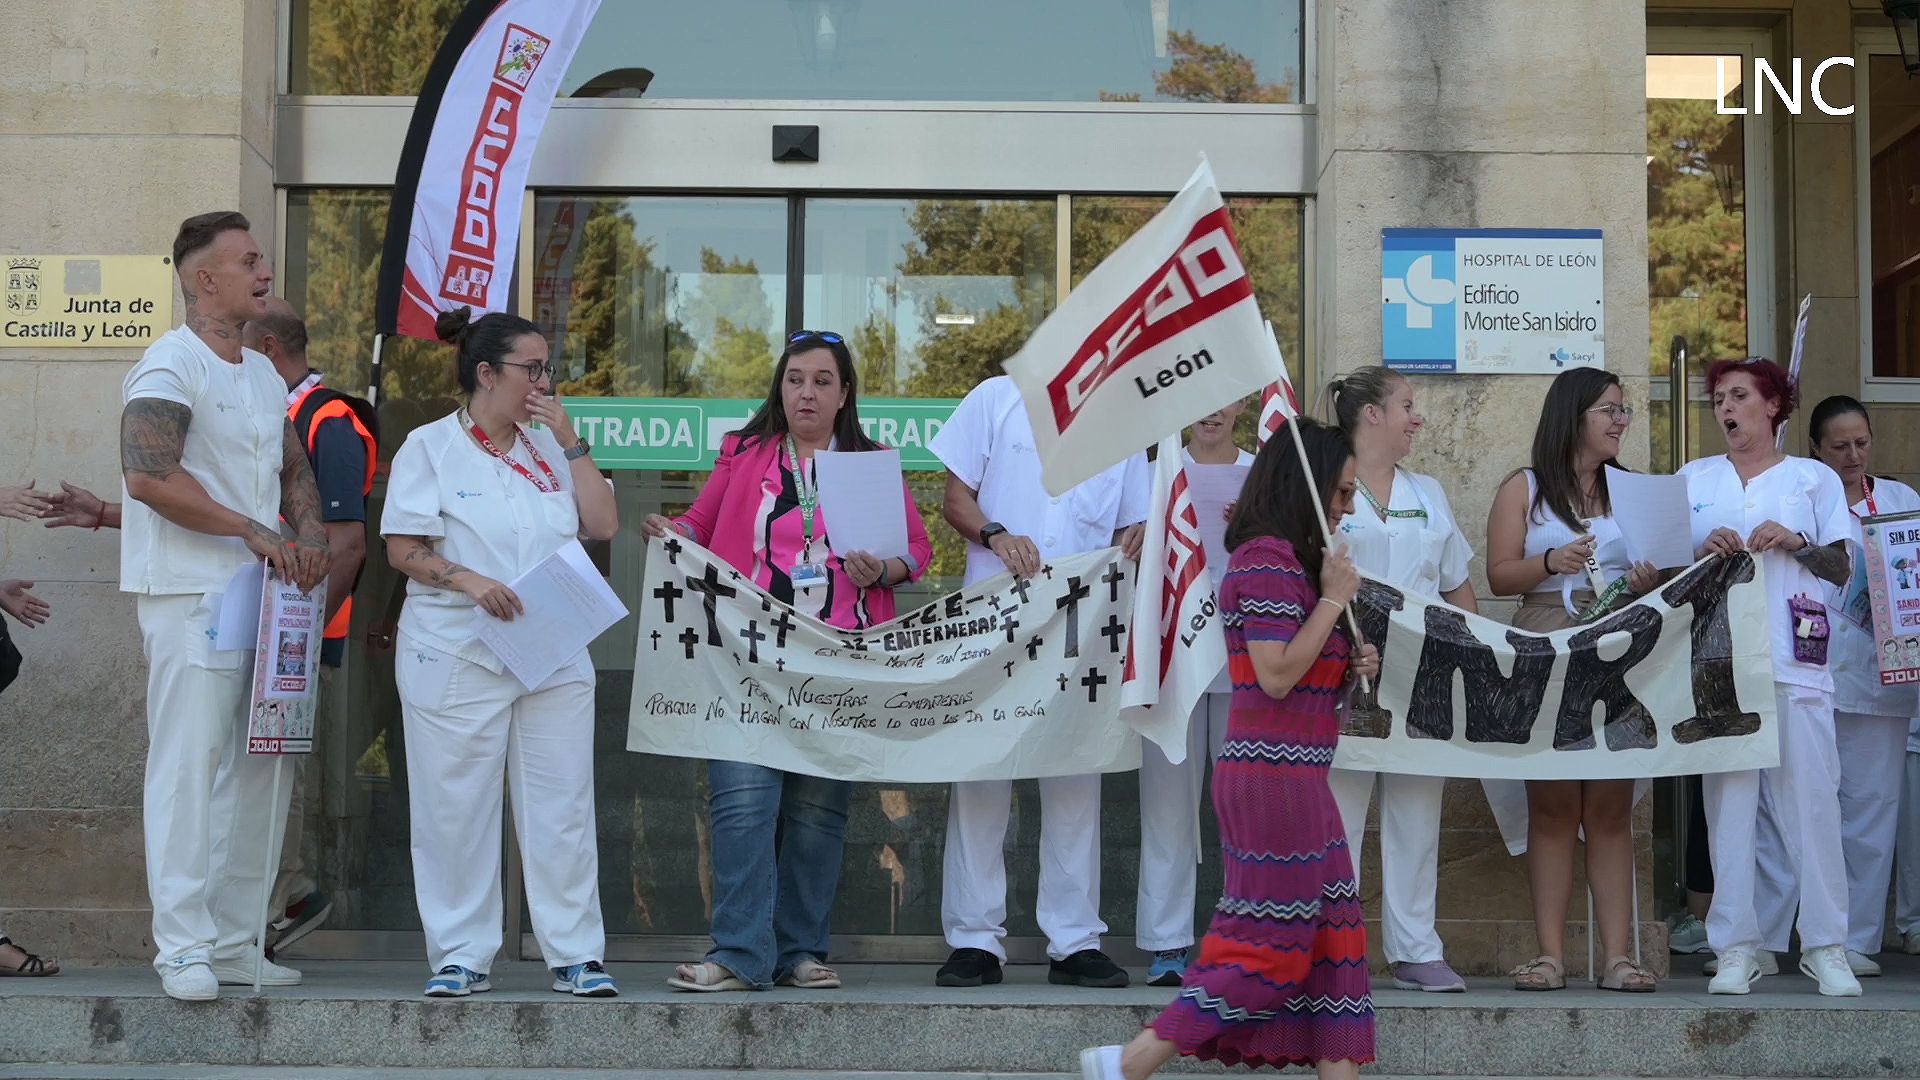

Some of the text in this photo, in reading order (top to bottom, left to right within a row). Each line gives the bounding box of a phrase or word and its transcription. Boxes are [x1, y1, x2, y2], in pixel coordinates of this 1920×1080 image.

[1464, 252, 1596, 267] HOSPITAL DE LEÓN
[64, 297, 154, 313] Junta de
[1464, 284, 1519, 305] Edificio
[5, 320, 151, 342] Castilla y León
[1464, 311, 1597, 331] Monte San Isidro
[1134, 347, 1214, 399] León
[541, 416, 695, 448] TRADA
[1888, 530, 1905, 544] SIN
[1337, 550, 1762, 752] INRI
[788, 677, 868, 708] NUESTRAS
[645, 692, 697, 716] PORQUE
[740, 702, 784, 726] HAGAN
[789, 713, 814, 730] CON
[886, 717, 901, 729] LO
[993, 708, 1006, 721] LA
